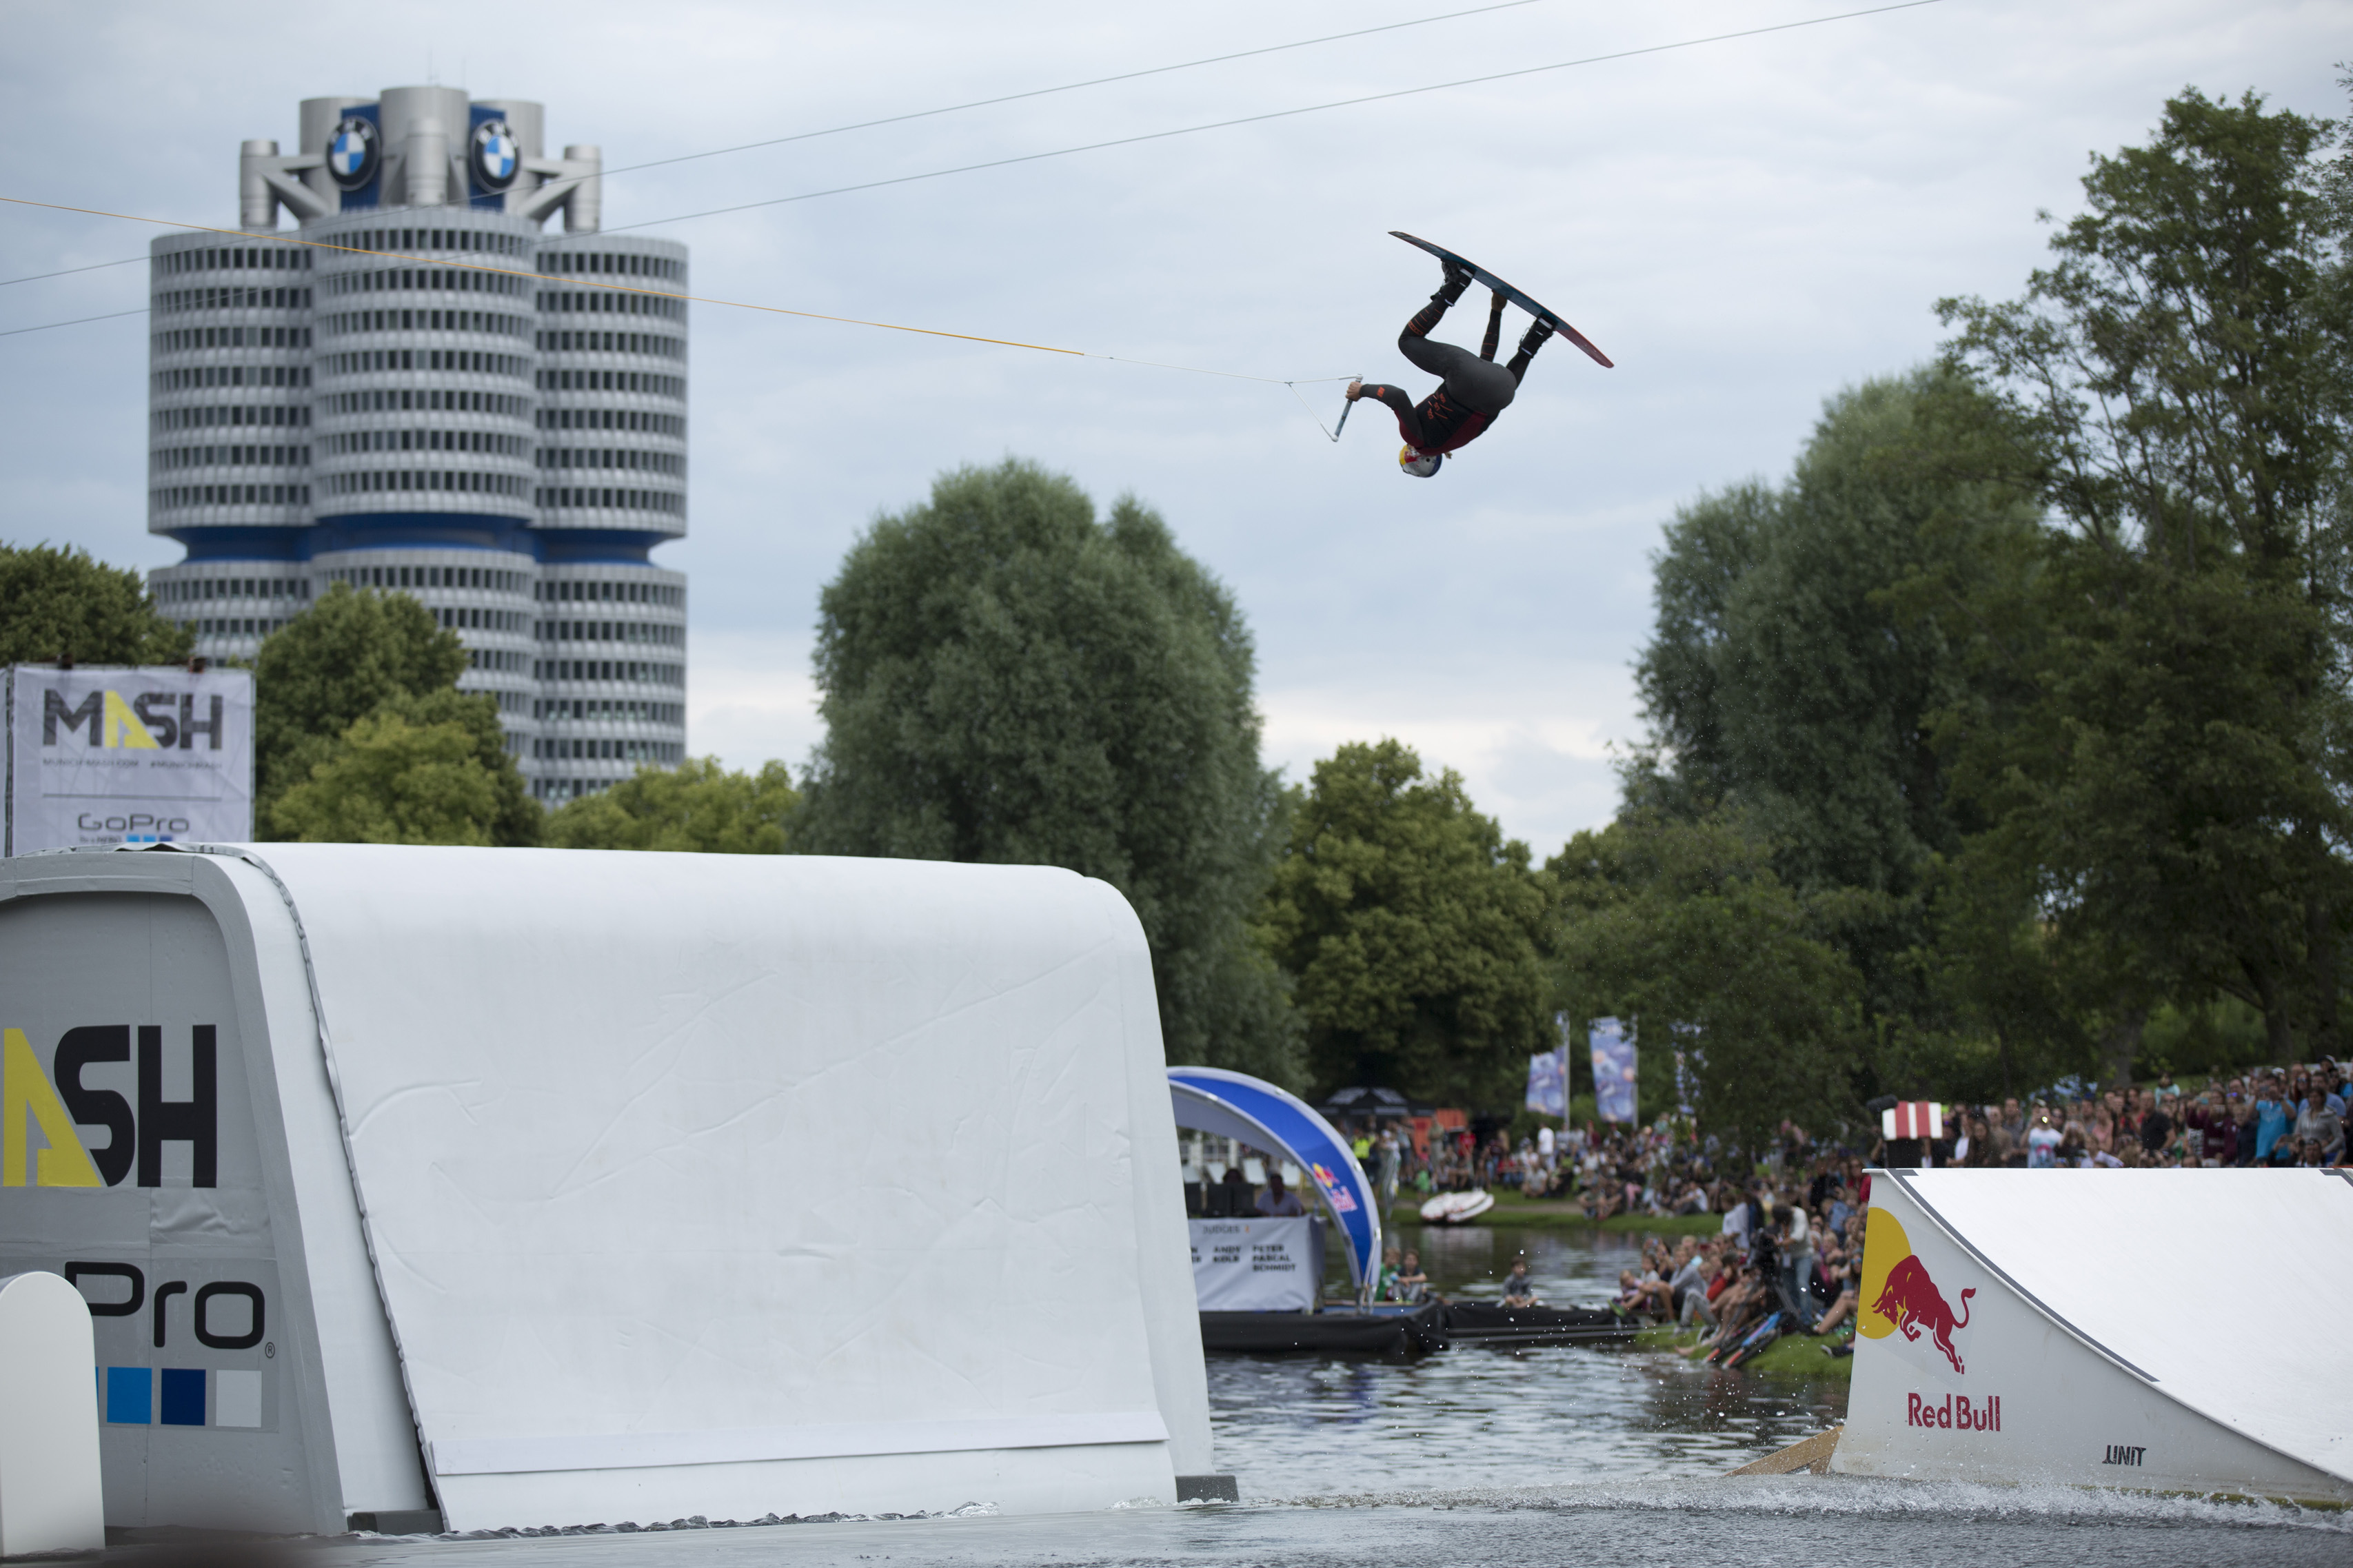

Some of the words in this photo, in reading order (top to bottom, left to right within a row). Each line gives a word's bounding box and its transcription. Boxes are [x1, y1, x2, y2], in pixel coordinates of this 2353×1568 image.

[43, 689, 223, 750] MASH
[78, 813, 190, 833] GoPro
[1203, 1225, 1240, 1234] JUDGES
[1253, 1263, 1296, 1272] SCHMIDT
[1908, 1392, 1952, 1429] Red
[1956, 1395, 2001, 1432] Bull
